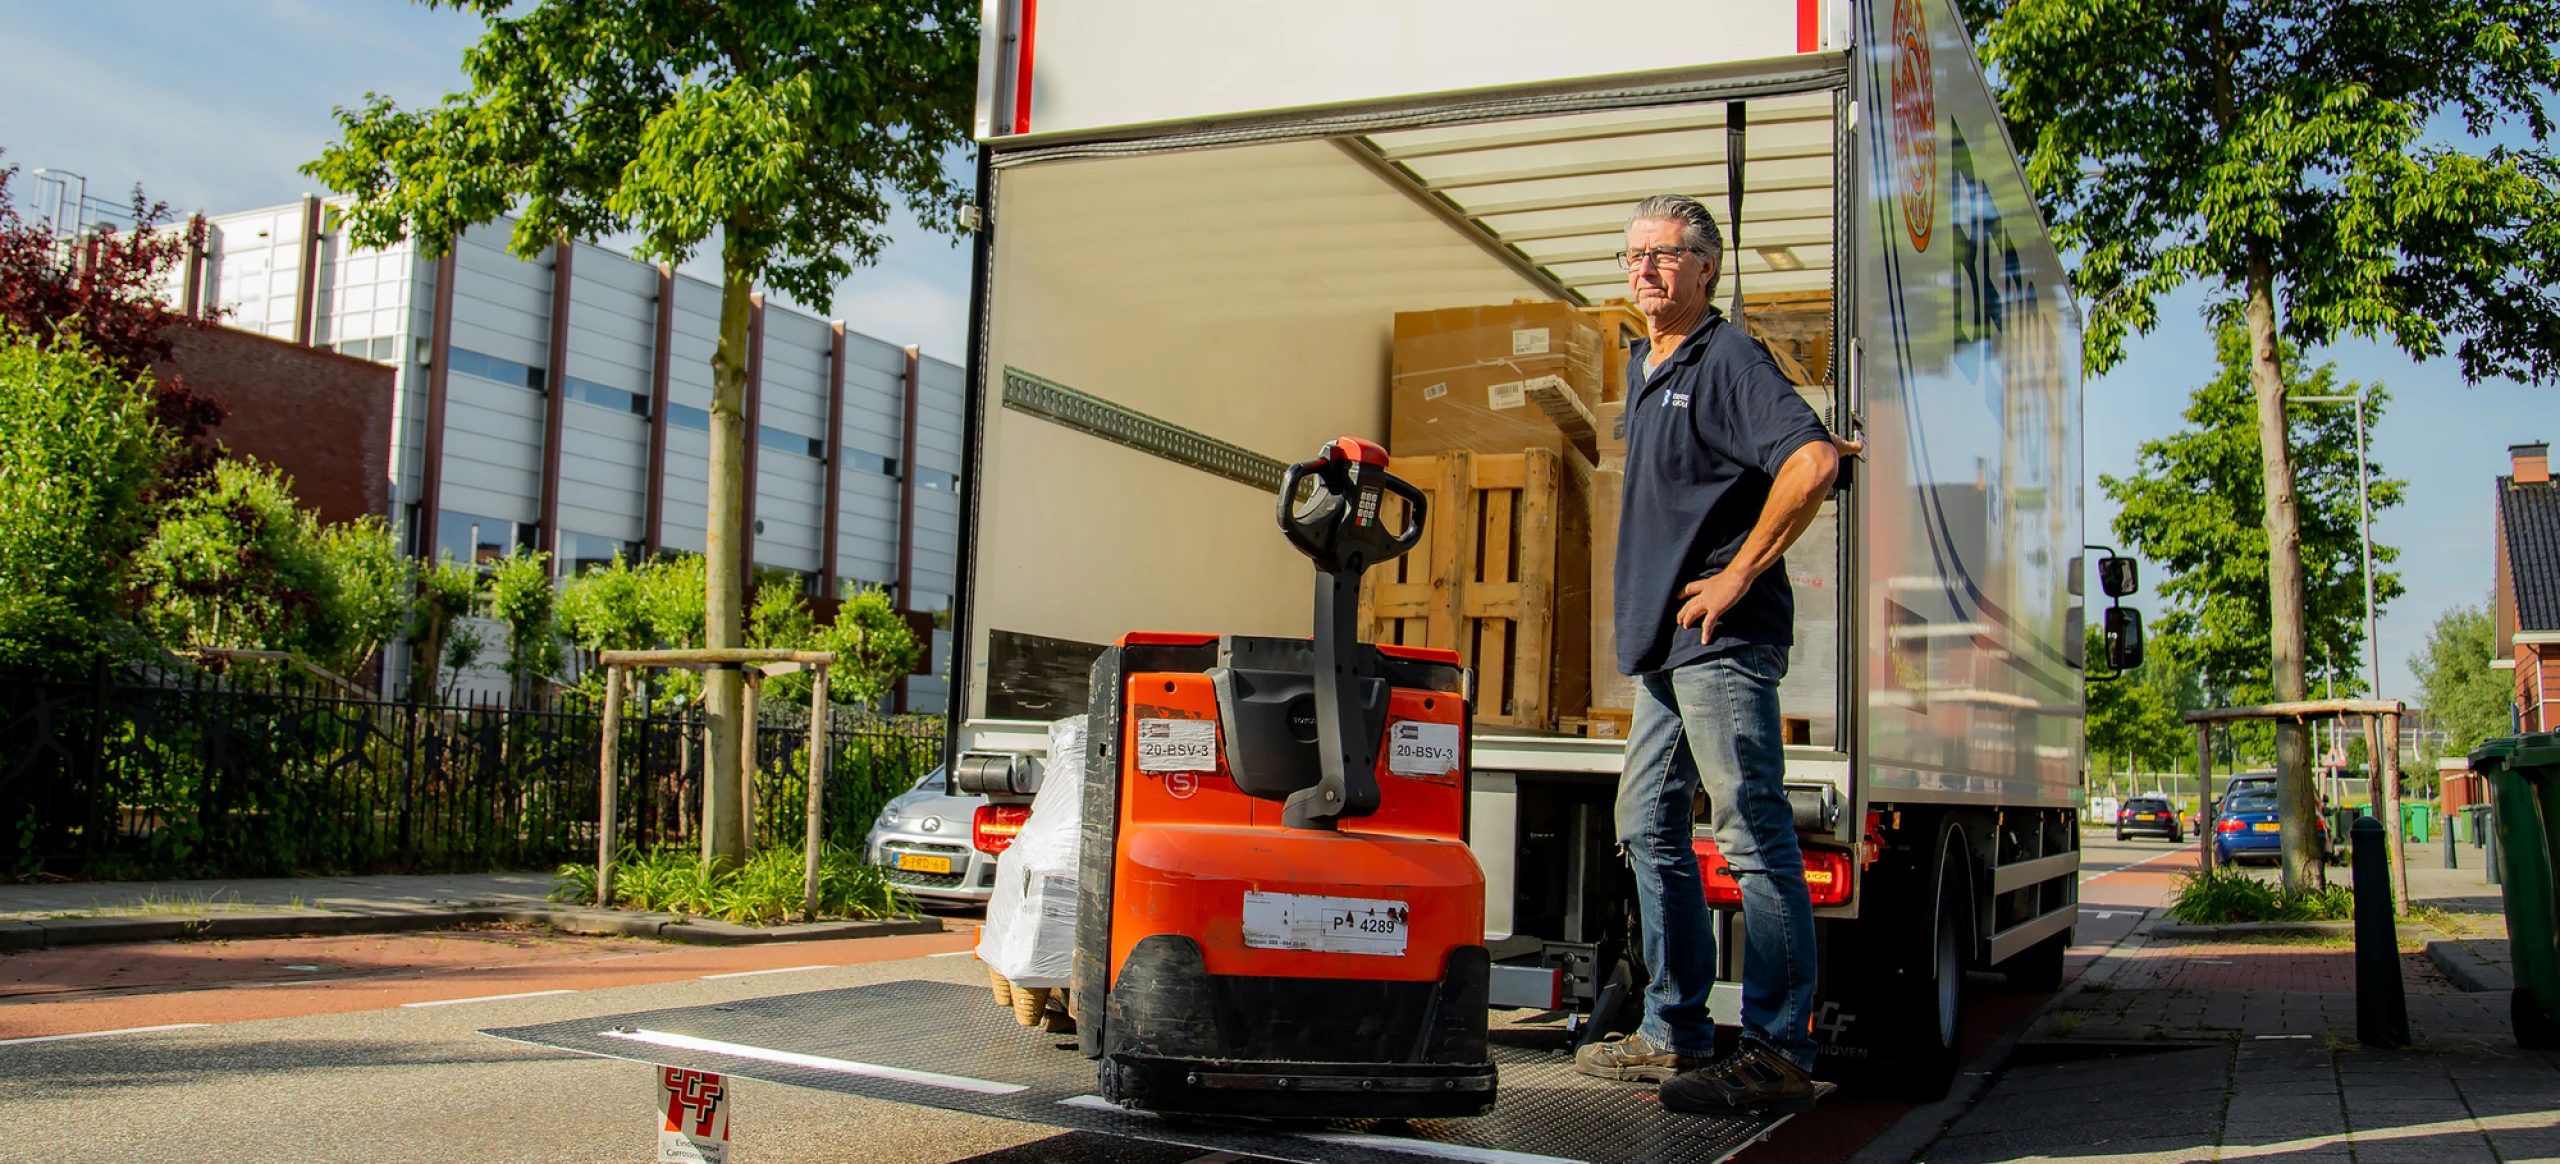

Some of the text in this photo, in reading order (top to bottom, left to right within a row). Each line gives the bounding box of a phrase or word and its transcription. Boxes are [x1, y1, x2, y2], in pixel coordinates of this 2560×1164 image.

[1293, 717, 1317, 725] TOYO
[1146, 744, 1209, 757] 20-BSV-3
[1396, 744, 1454, 760] 20-BSV-3
[1333, 917, 1344, 931] P
[1360, 918, 1395, 934] 4289
[1814, 1001, 1856, 1043] CF
[1819, 1043, 1868, 1059] HOVEN
